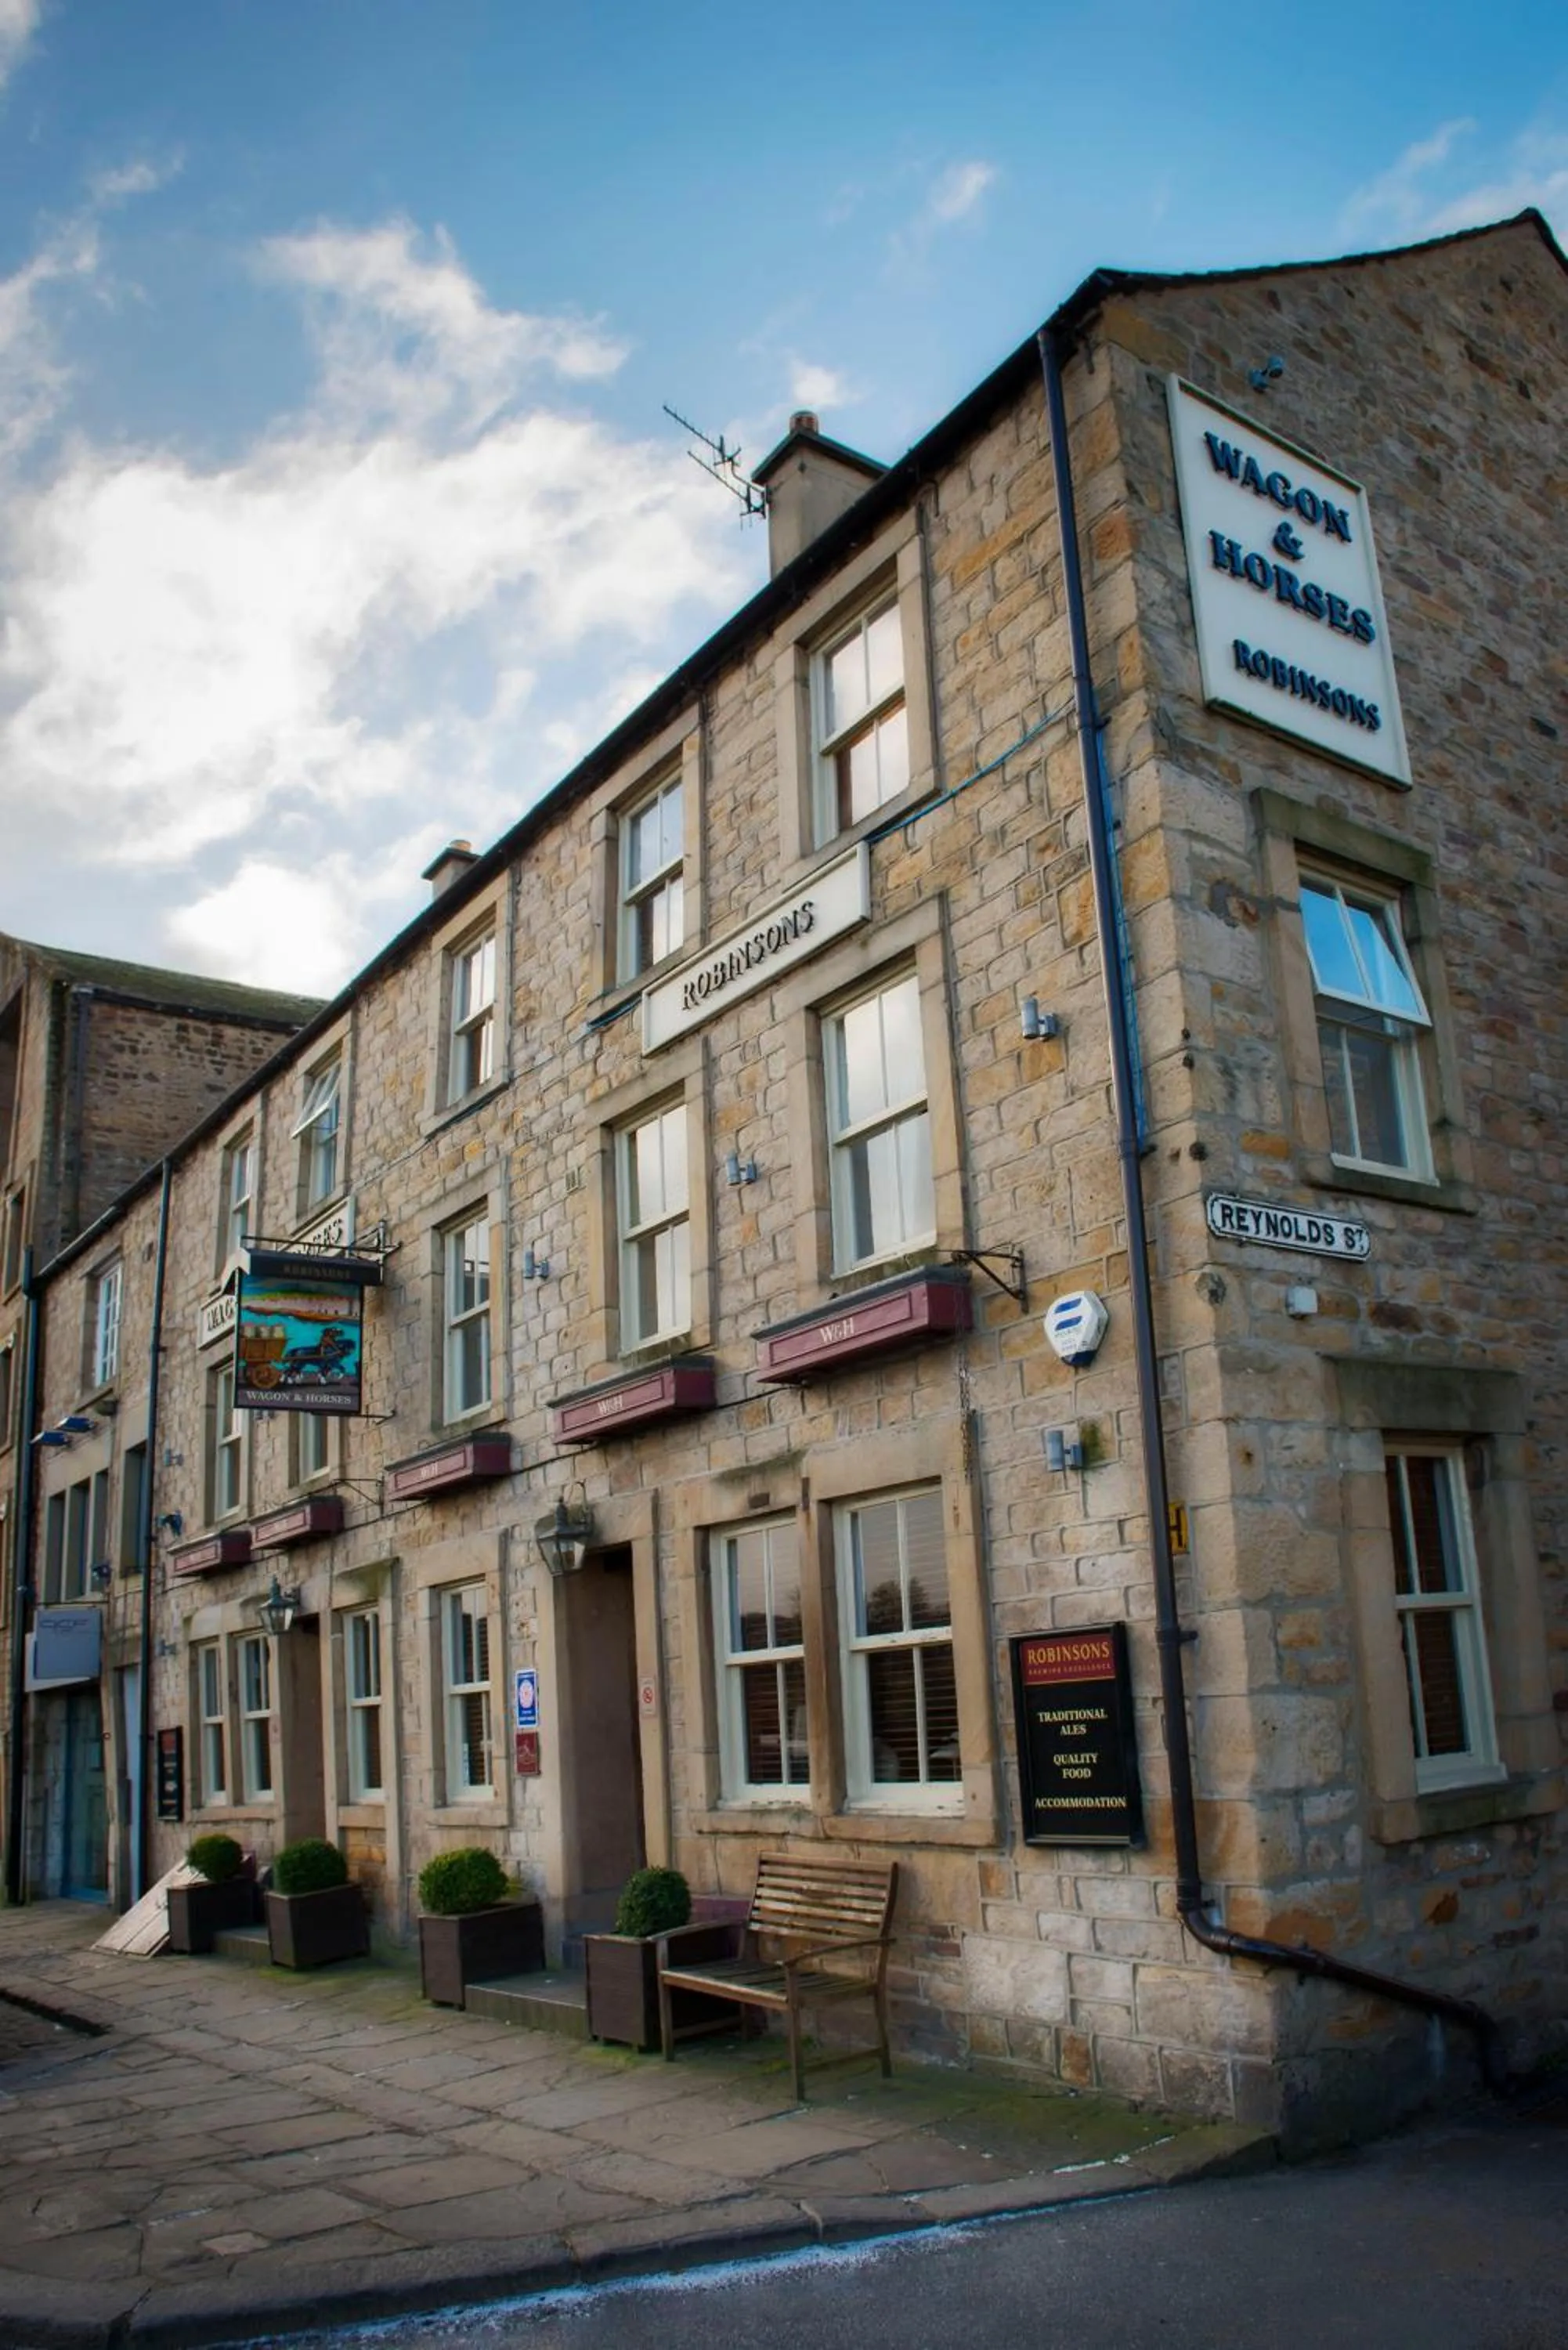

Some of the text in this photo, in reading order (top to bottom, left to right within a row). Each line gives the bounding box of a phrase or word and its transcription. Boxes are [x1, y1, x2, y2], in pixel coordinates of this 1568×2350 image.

[1204, 431, 1353, 544] WAGON
[1272, 520, 1306, 561] &
[1209, 530, 1376, 645] HORSES
[1233, 638, 1382, 733] ROBINSONS
[682, 901, 813, 1010] ROBINSONS
[1220, 1203, 1335, 1246] REYNOLDS
[246, 1390, 291, 1402] WAGON
[305, 1394, 352, 1405] HORSES
[1028, 1641, 1110, 1665] ROBINSONS
[1037, 1708, 1108, 1723] TRADITIONAL
[1060, 1724, 1086, 1736] ALES
[1053, 1752, 1098, 1766] QUALITY
[1062, 1767, 1092, 1779] FOOD
[1035, 1796, 1127, 1809] ACCOMMODATION
